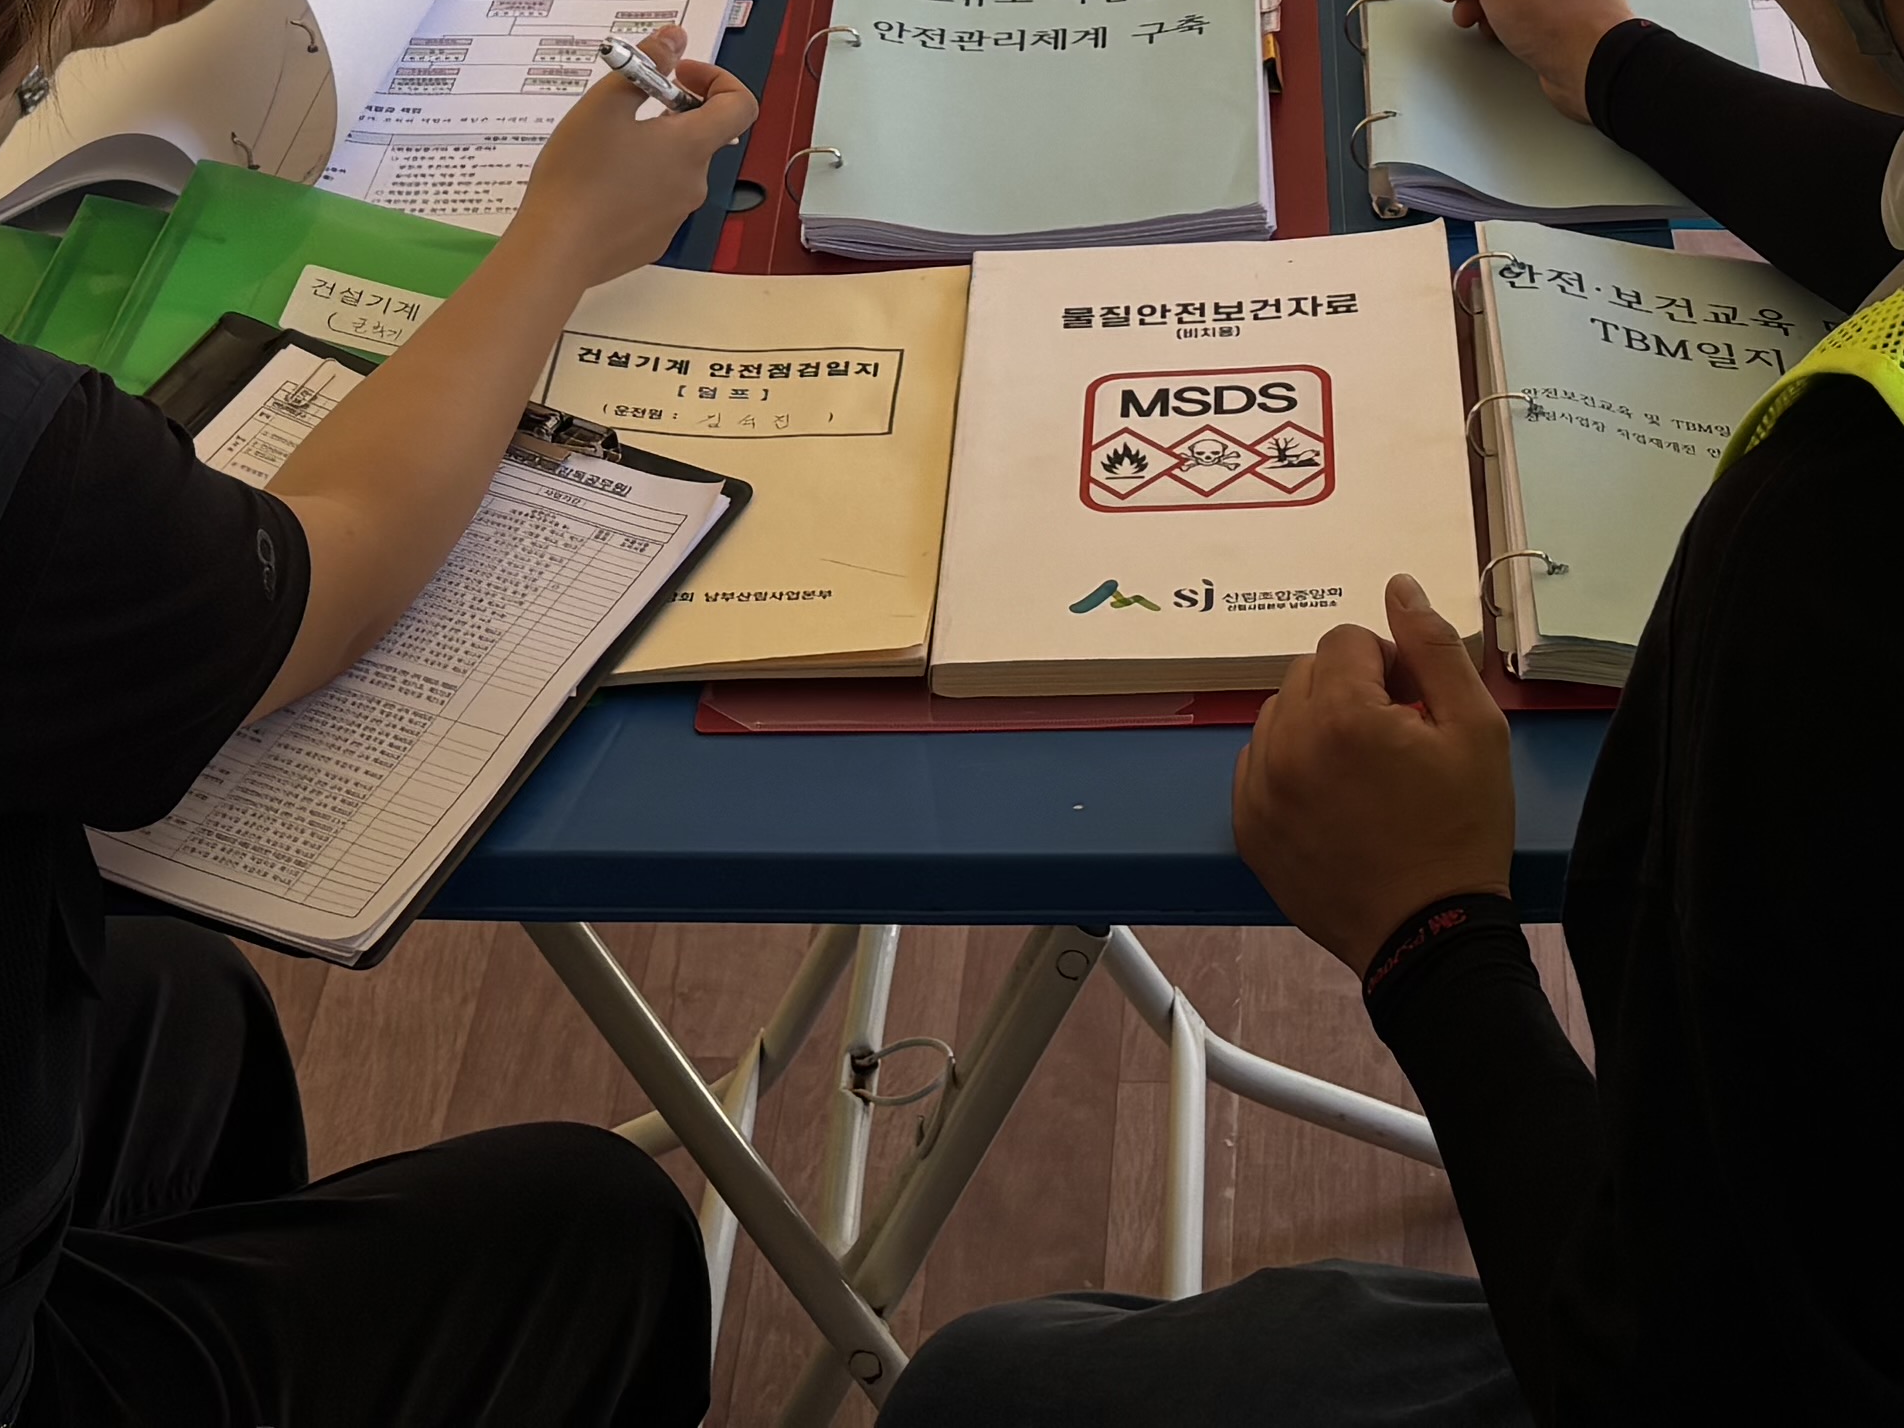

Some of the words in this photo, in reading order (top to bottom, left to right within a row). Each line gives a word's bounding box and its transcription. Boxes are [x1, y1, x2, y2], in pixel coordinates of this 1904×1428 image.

[872, 19, 1108, 53] 안전관리체계
[1131, 14, 1211, 45] 구축
[312, 278, 420, 322] 건설기계
[1060, 292, 1360, 330] 물질안전보건자료
[1498, 263, 1795, 338] 안전·보건교육
[1176, 324, 1240, 340] (비치용)
[1590, 315, 1786, 377] TBM일지
[577, 346, 691, 376] 건설기계
[708, 359, 880, 380] 안전점검일지
[1119, 382, 1298, 419] MSDS
